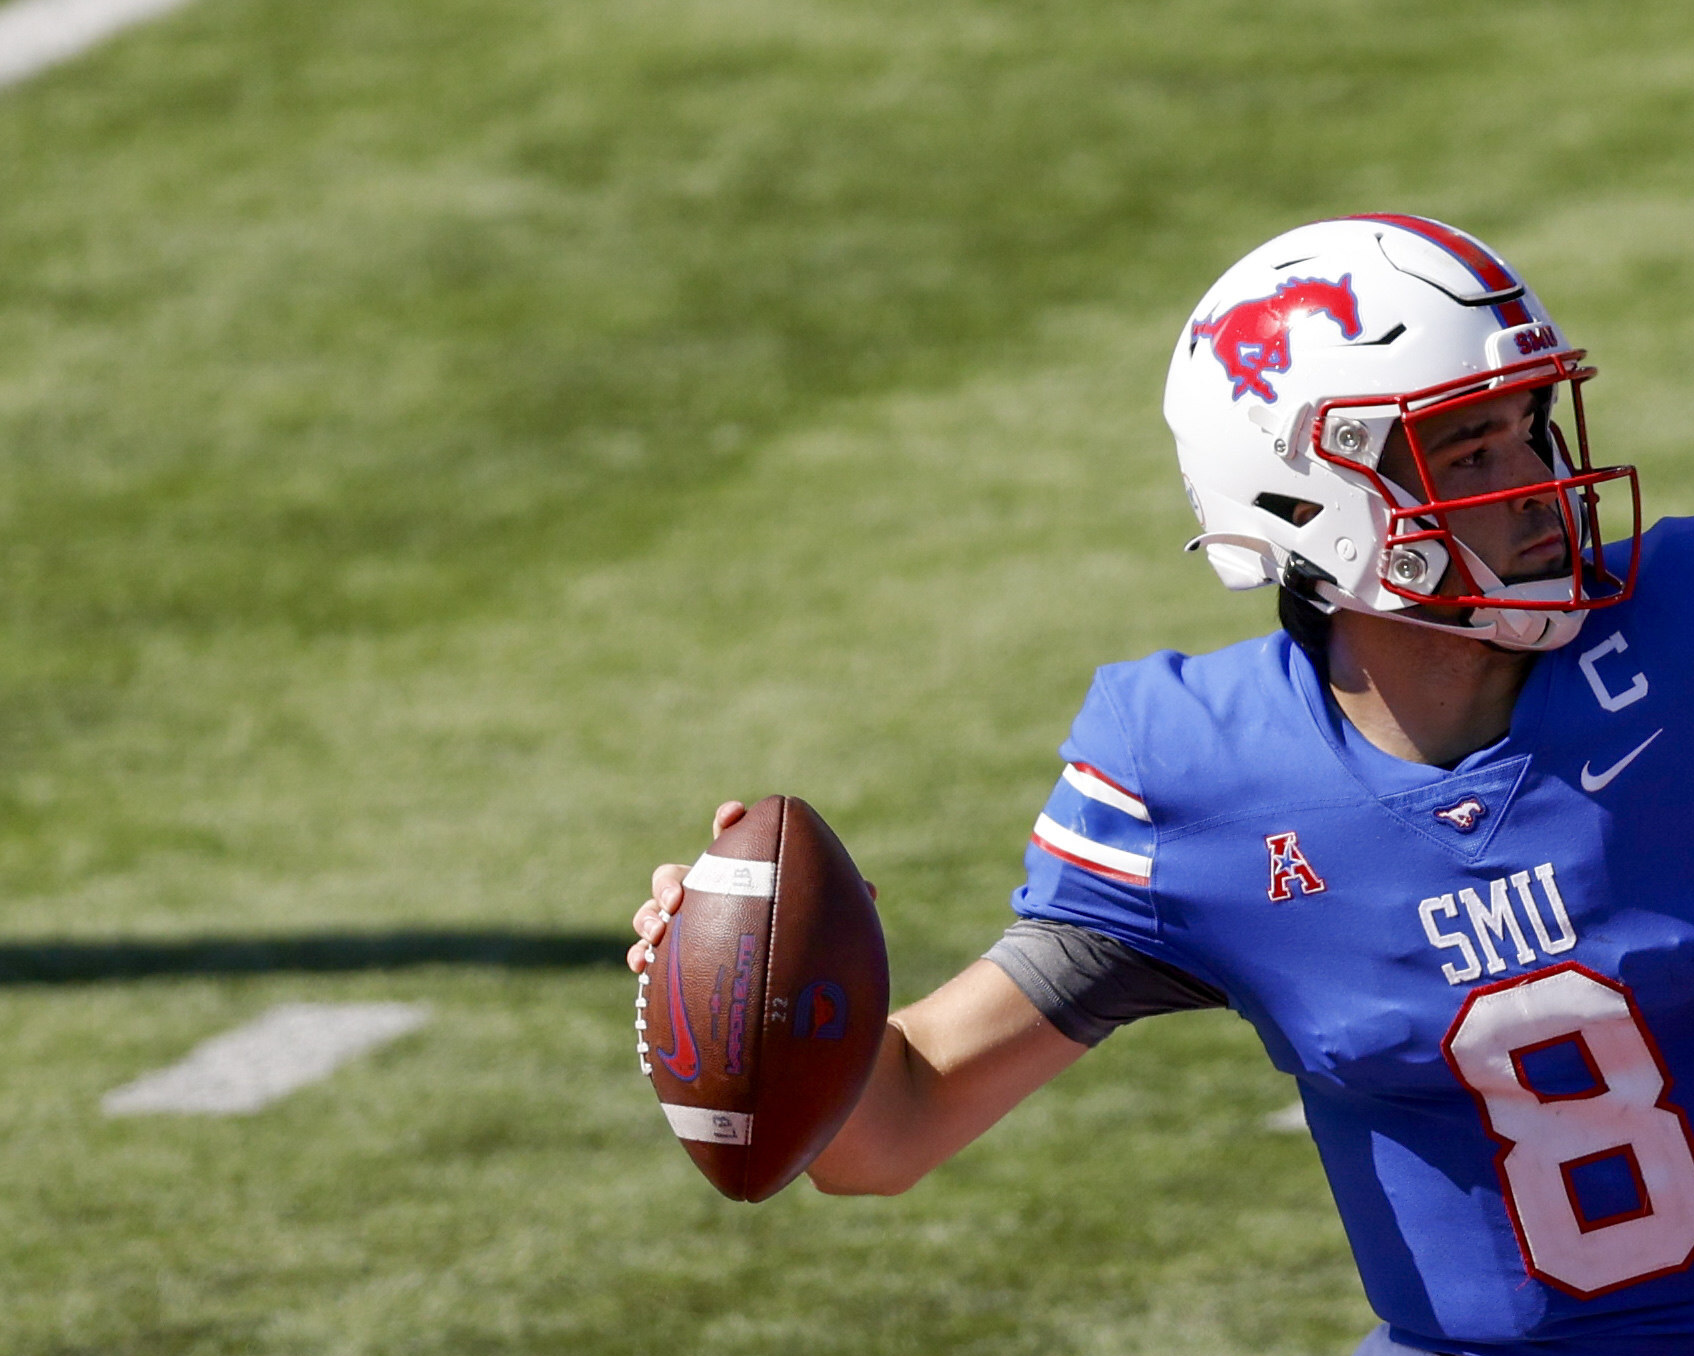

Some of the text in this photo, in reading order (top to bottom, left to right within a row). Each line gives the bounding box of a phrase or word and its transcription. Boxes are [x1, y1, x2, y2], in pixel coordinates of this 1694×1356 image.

[1514, 325, 1558, 354] SMU
[1578, 630, 1649, 713] C
[1264, 831, 1326, 902] A
[1417, 862, 1578, 986] SMU
